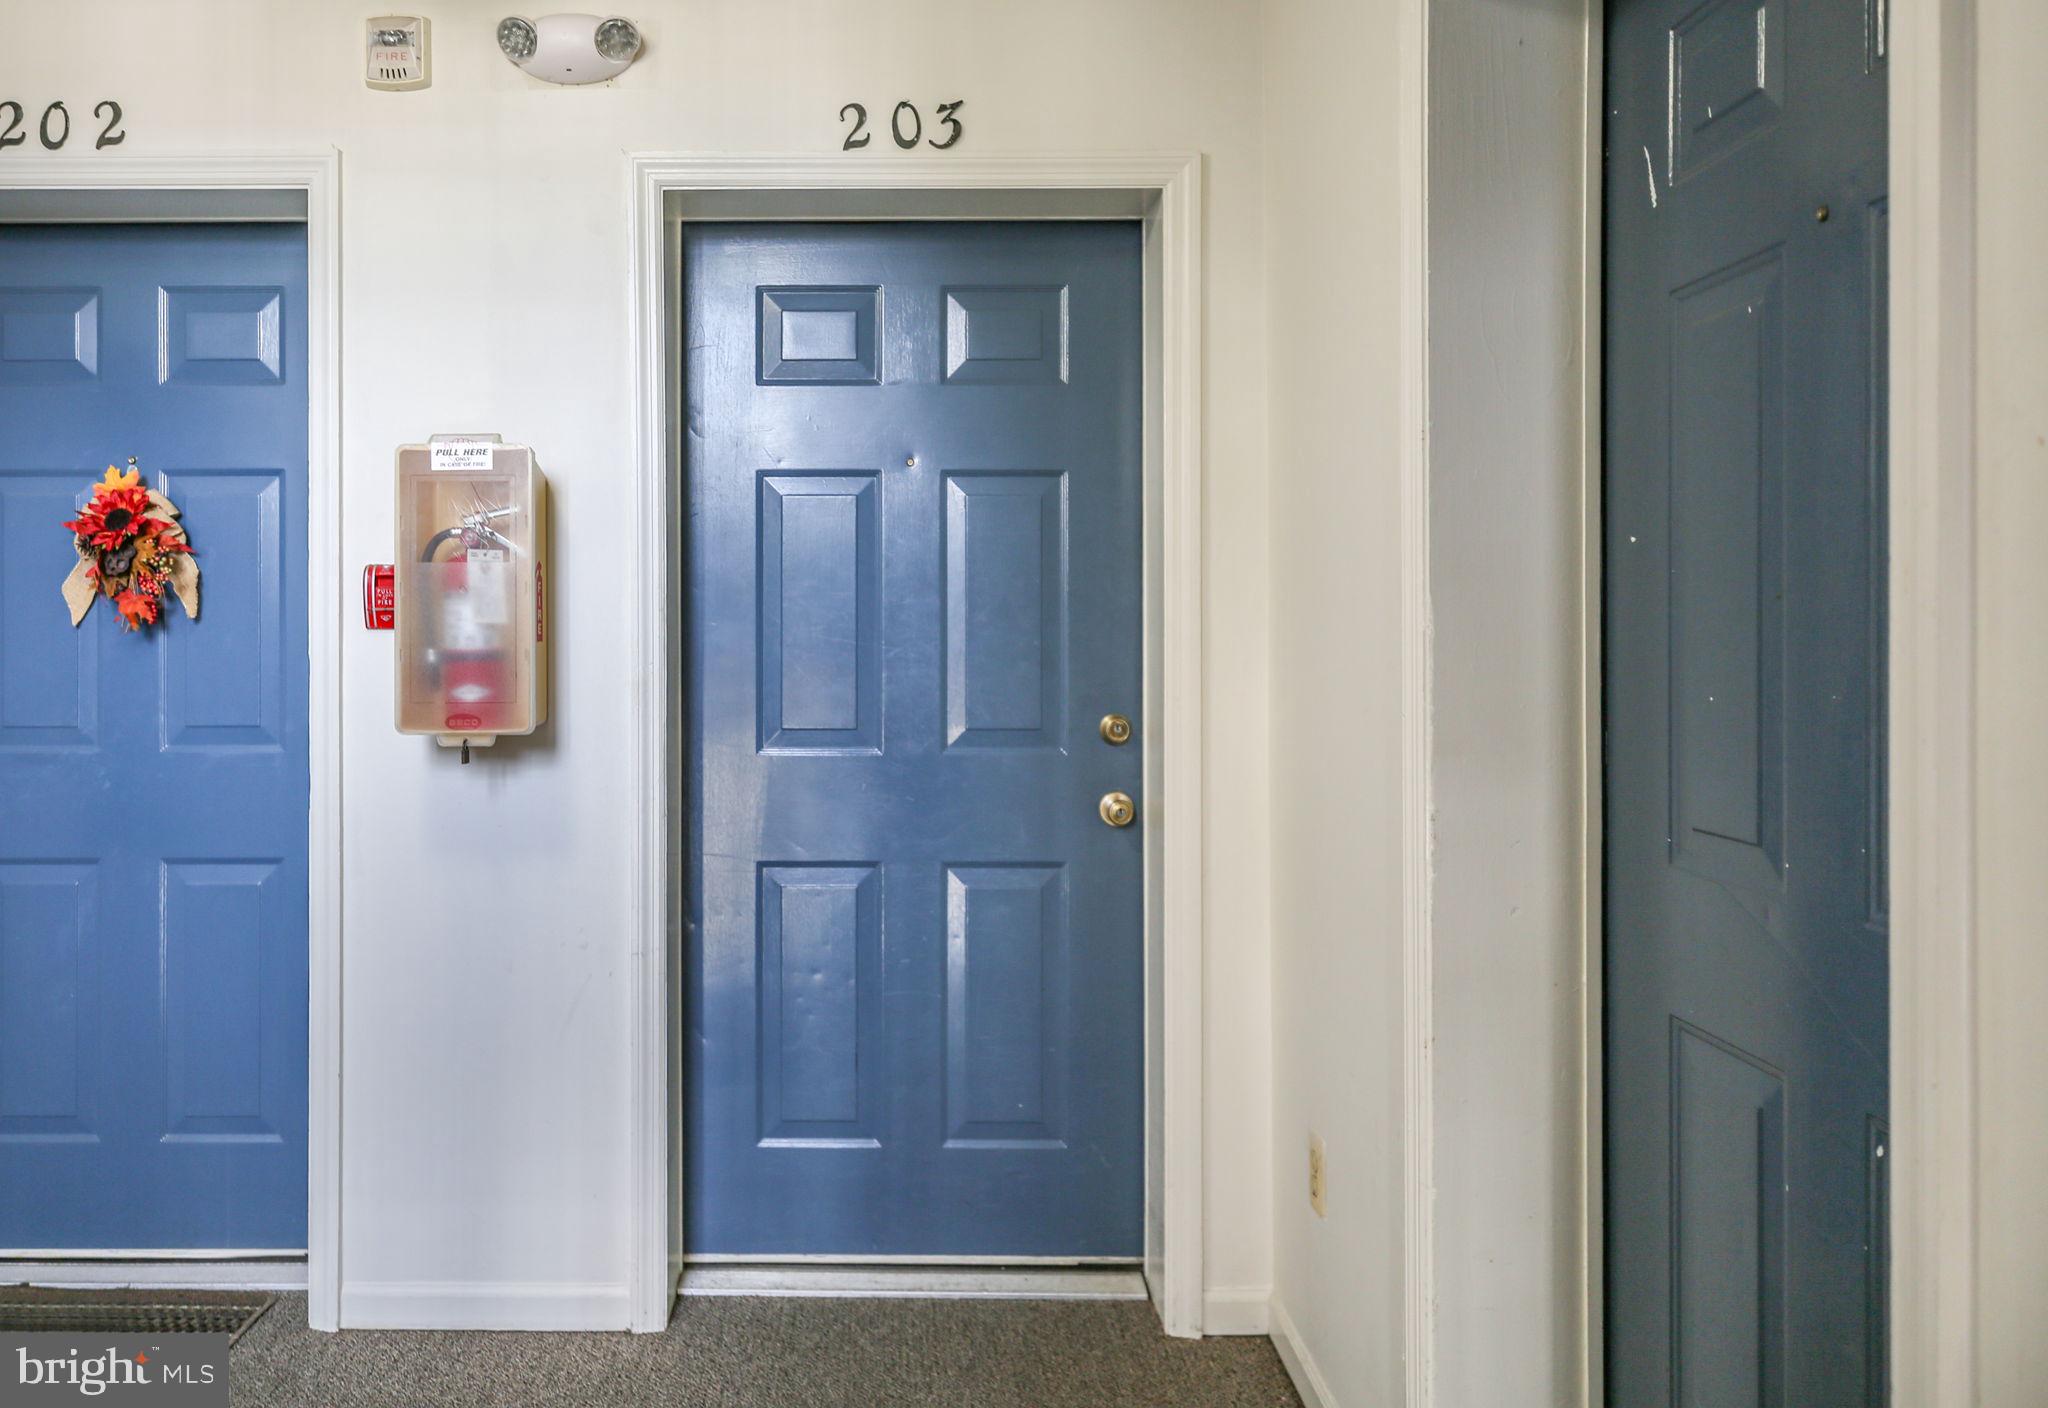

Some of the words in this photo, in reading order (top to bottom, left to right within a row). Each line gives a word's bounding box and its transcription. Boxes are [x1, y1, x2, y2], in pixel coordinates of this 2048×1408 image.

[376, 51, 408, 61] FIRE
[0, 100, 126, 151] 202
[839, 99, 965, 152] 203
[435, 448, 460, 457] PULL
[463, 448, 489, 456] HERE
